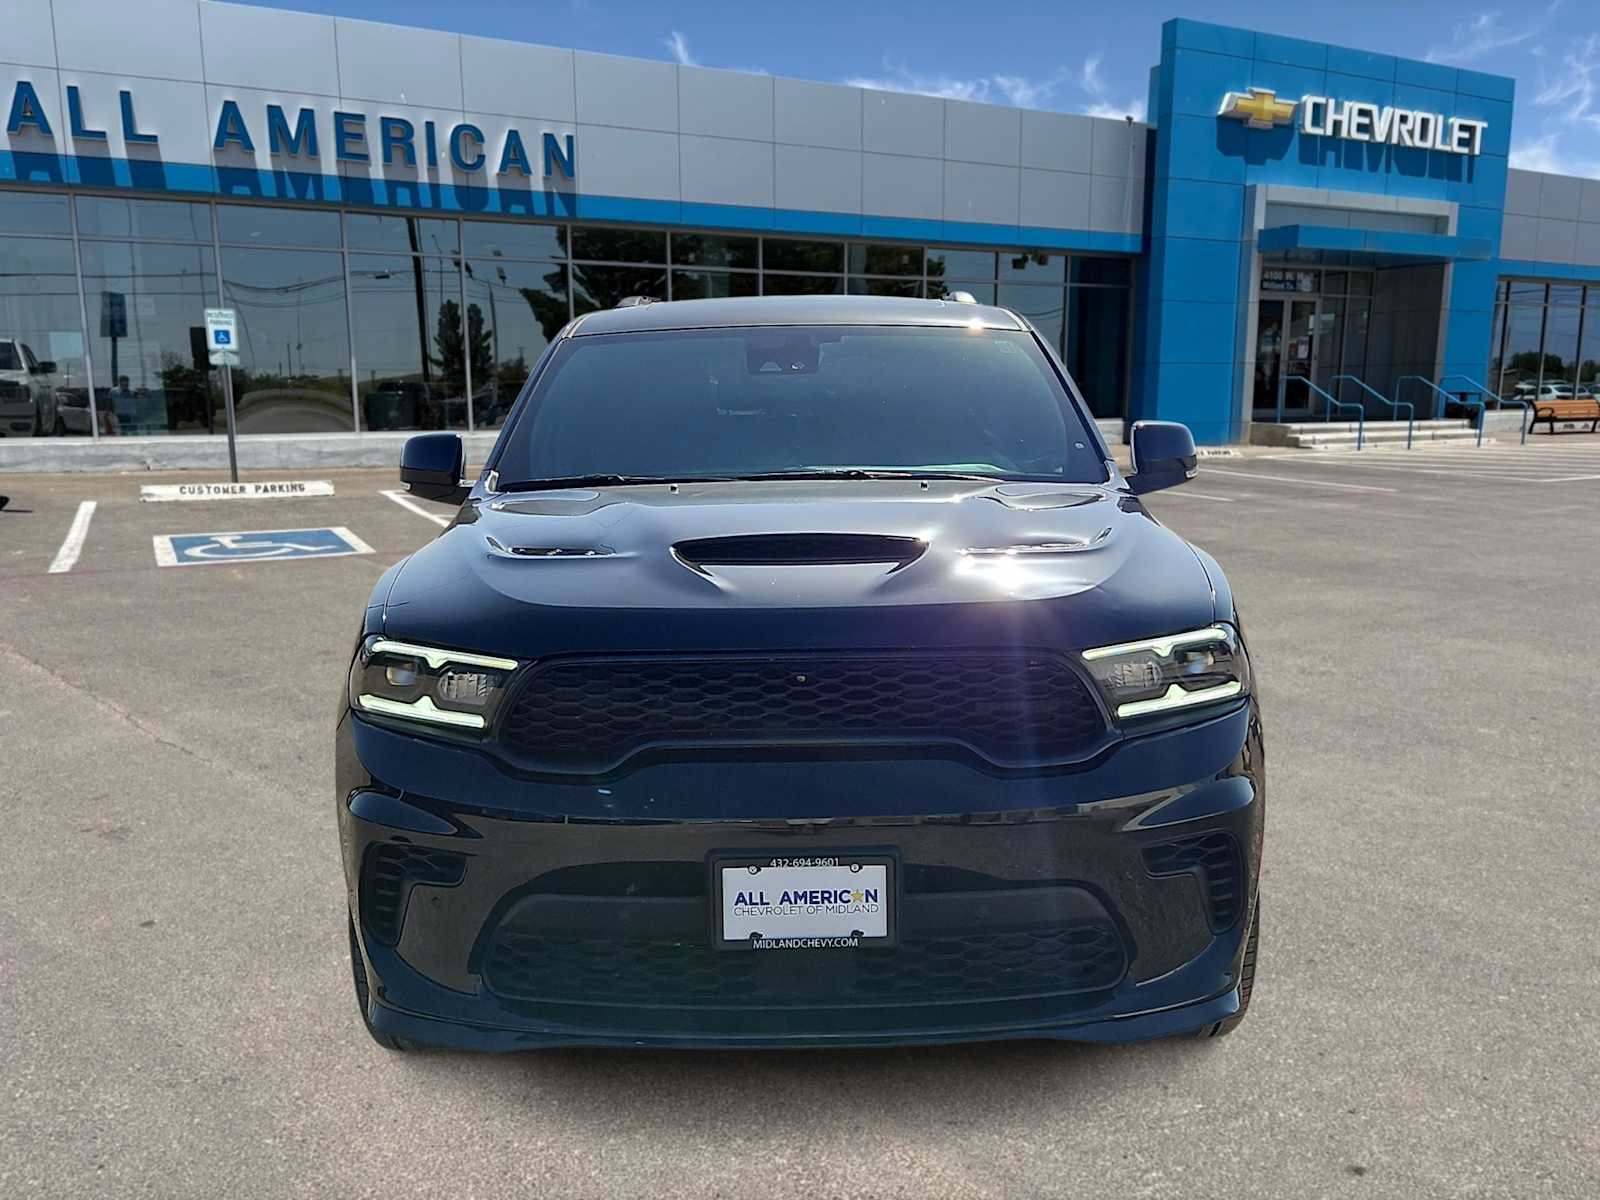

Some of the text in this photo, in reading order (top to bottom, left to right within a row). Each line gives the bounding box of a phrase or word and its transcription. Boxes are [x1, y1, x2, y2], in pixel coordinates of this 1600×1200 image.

[7, 80, 575, 179] ALL AMERICAN
[1302, 95, 1488, 155] CHEVROLET
[179, 483, 305, 495] CUSTOMER PARKING
[770, 857, 839, 867] 432-694-9601
[734, 891, 769, 906] ALL
[734, 904, 879, 916] CHEVROLET OF MIDLAND
[752, 938, 859, 949] MIDLANDCHEVY.COM
